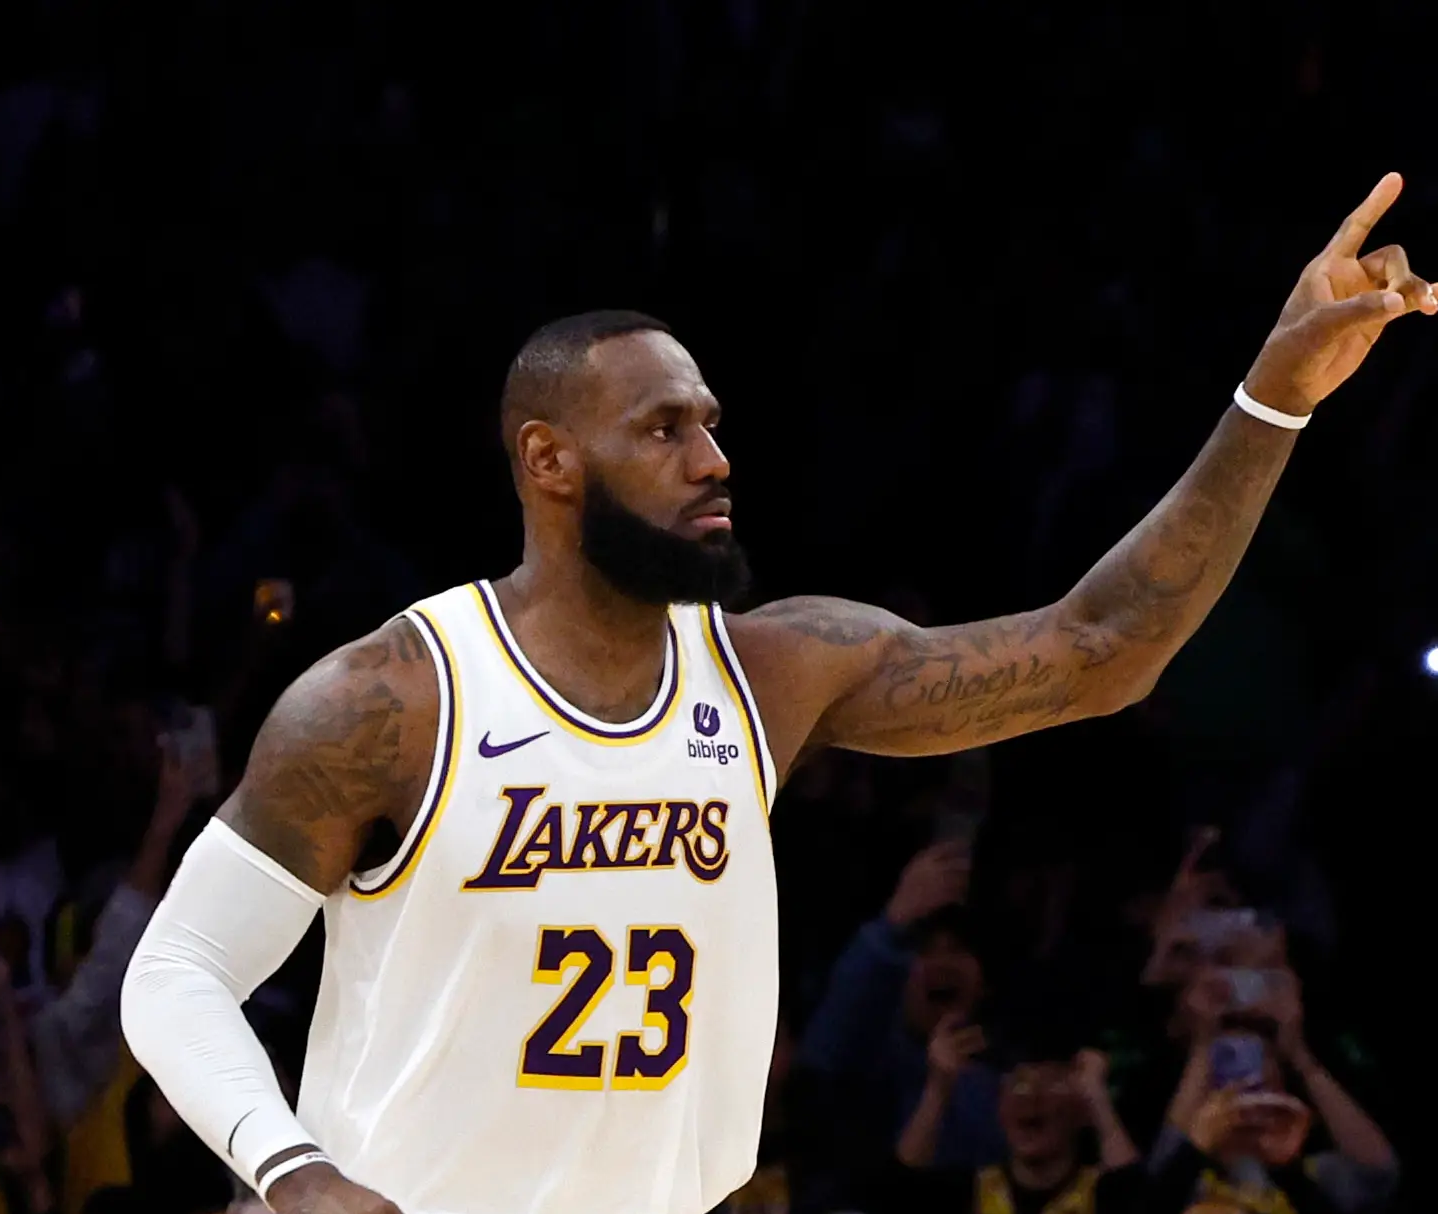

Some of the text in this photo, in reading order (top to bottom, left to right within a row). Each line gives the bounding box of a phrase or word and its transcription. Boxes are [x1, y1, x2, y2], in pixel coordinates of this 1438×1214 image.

[687, 737, 739, 765] bibigo
[461, 784, 729, 892] LAKERS
[517, 924, 697, 1090] 23
